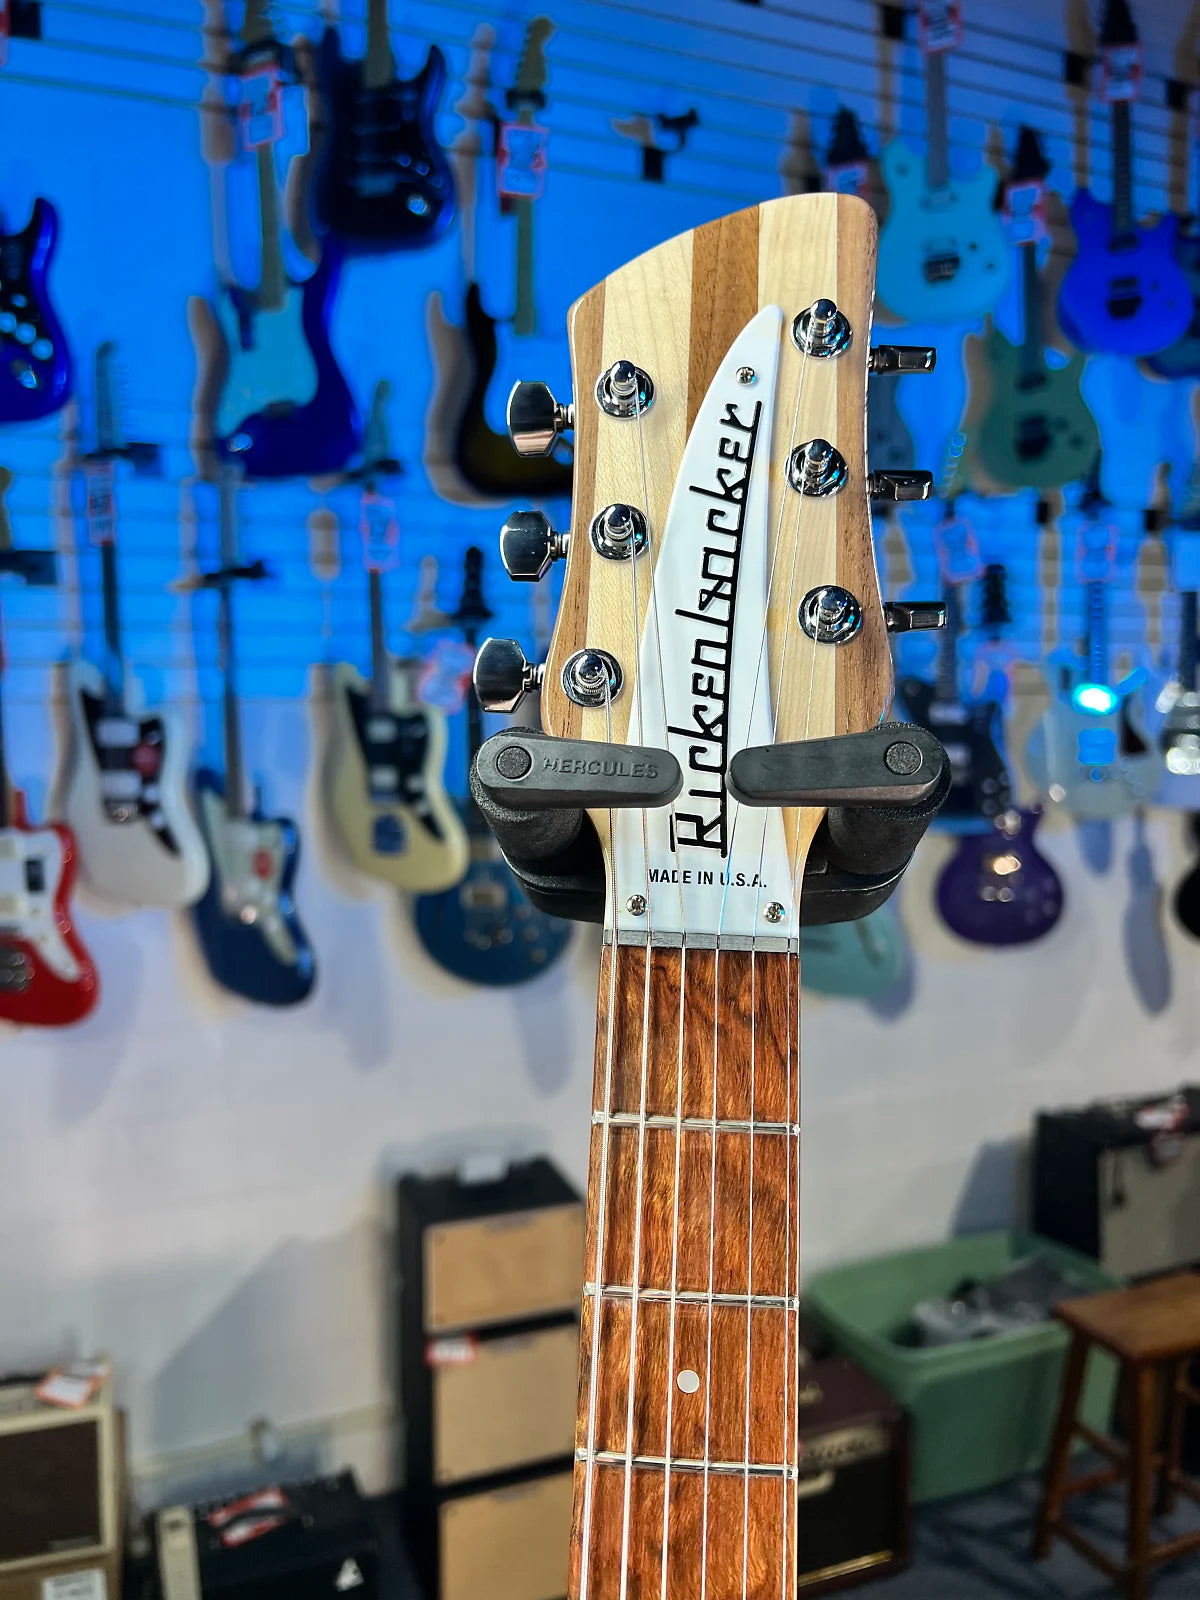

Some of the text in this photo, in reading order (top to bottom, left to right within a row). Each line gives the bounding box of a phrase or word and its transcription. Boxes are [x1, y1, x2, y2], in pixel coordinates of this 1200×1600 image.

[543, 757, 658, 779] HERCULES
[648, 868, 767, 888] MADE IN U.S.A.
